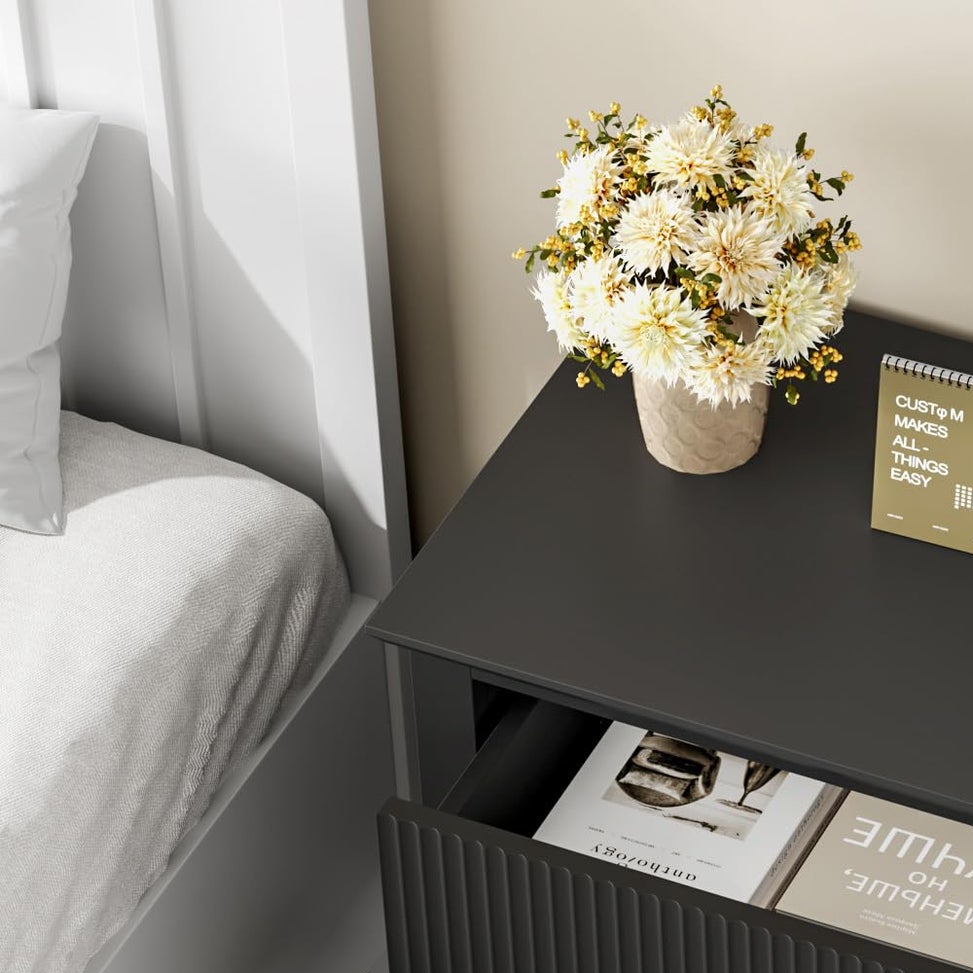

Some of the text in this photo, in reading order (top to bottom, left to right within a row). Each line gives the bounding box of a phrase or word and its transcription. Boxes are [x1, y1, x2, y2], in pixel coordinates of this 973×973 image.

[894, 414, 948, 439] MAKES
[891, 451, 949, 476] THINGS
[890, 467, 932, 488] EASY
